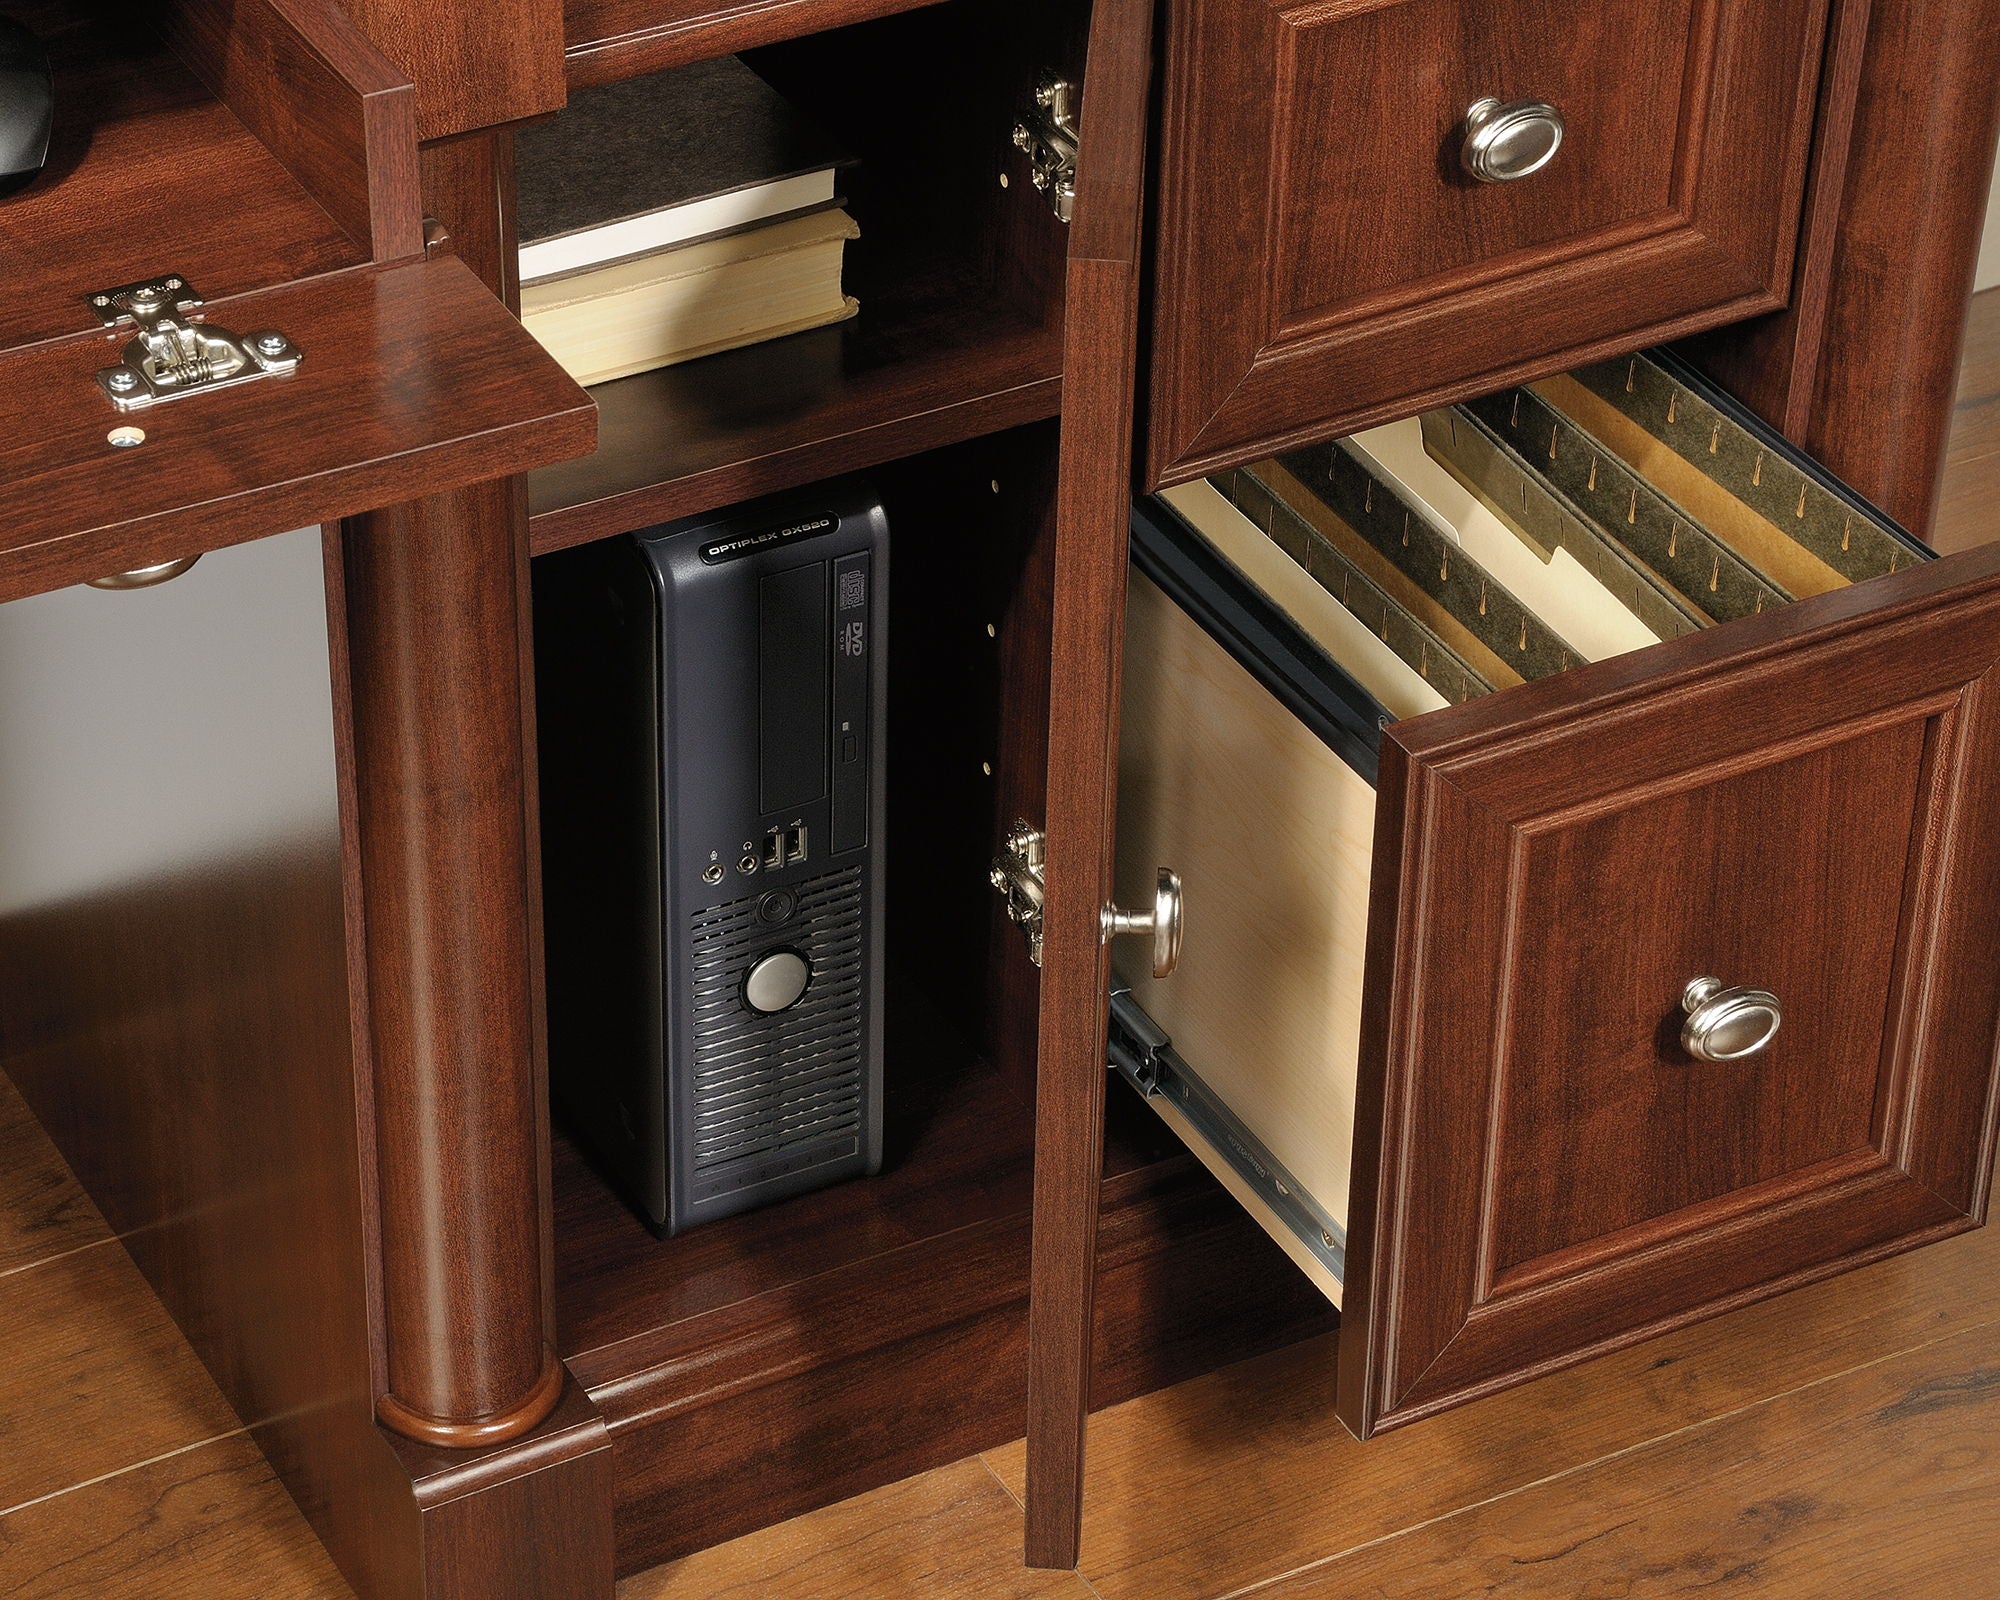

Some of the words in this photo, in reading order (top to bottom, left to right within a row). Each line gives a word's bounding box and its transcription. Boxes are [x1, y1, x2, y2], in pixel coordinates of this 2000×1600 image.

[708, 532, 778, 556] OPTIPLEX
[781, 519, 830, 536] GX520
[851, 621, 863, 656] DVD
